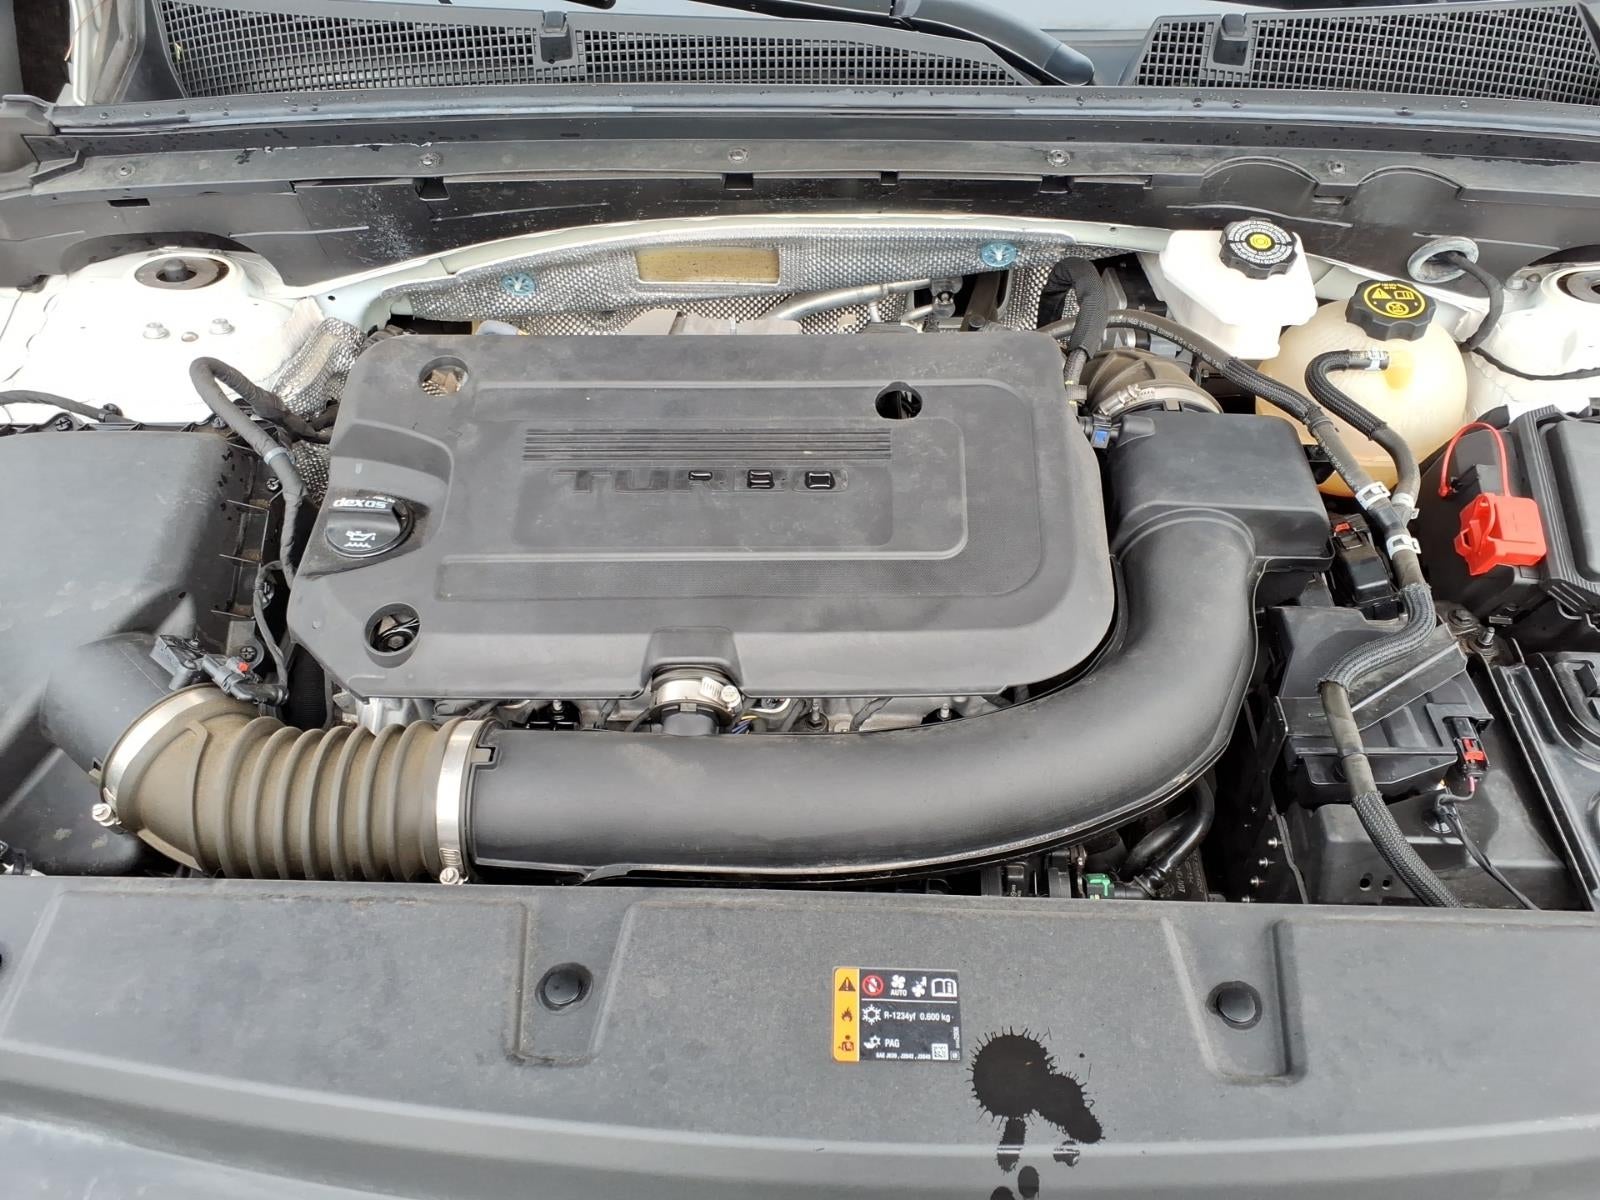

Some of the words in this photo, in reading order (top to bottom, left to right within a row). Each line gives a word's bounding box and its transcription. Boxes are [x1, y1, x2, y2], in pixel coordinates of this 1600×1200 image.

[553, 469, 848, 494] TURBO
[333, 497, 388, 509] dexos
[890, 989, 907, 997] AUTO
[883, 1011, 916, 1022] R-1234yf
[920, 1013, 940, 1021] 0.600
[941, 1013, 951, 1023] kg
[884, 1039, 900, 1048] PAG
